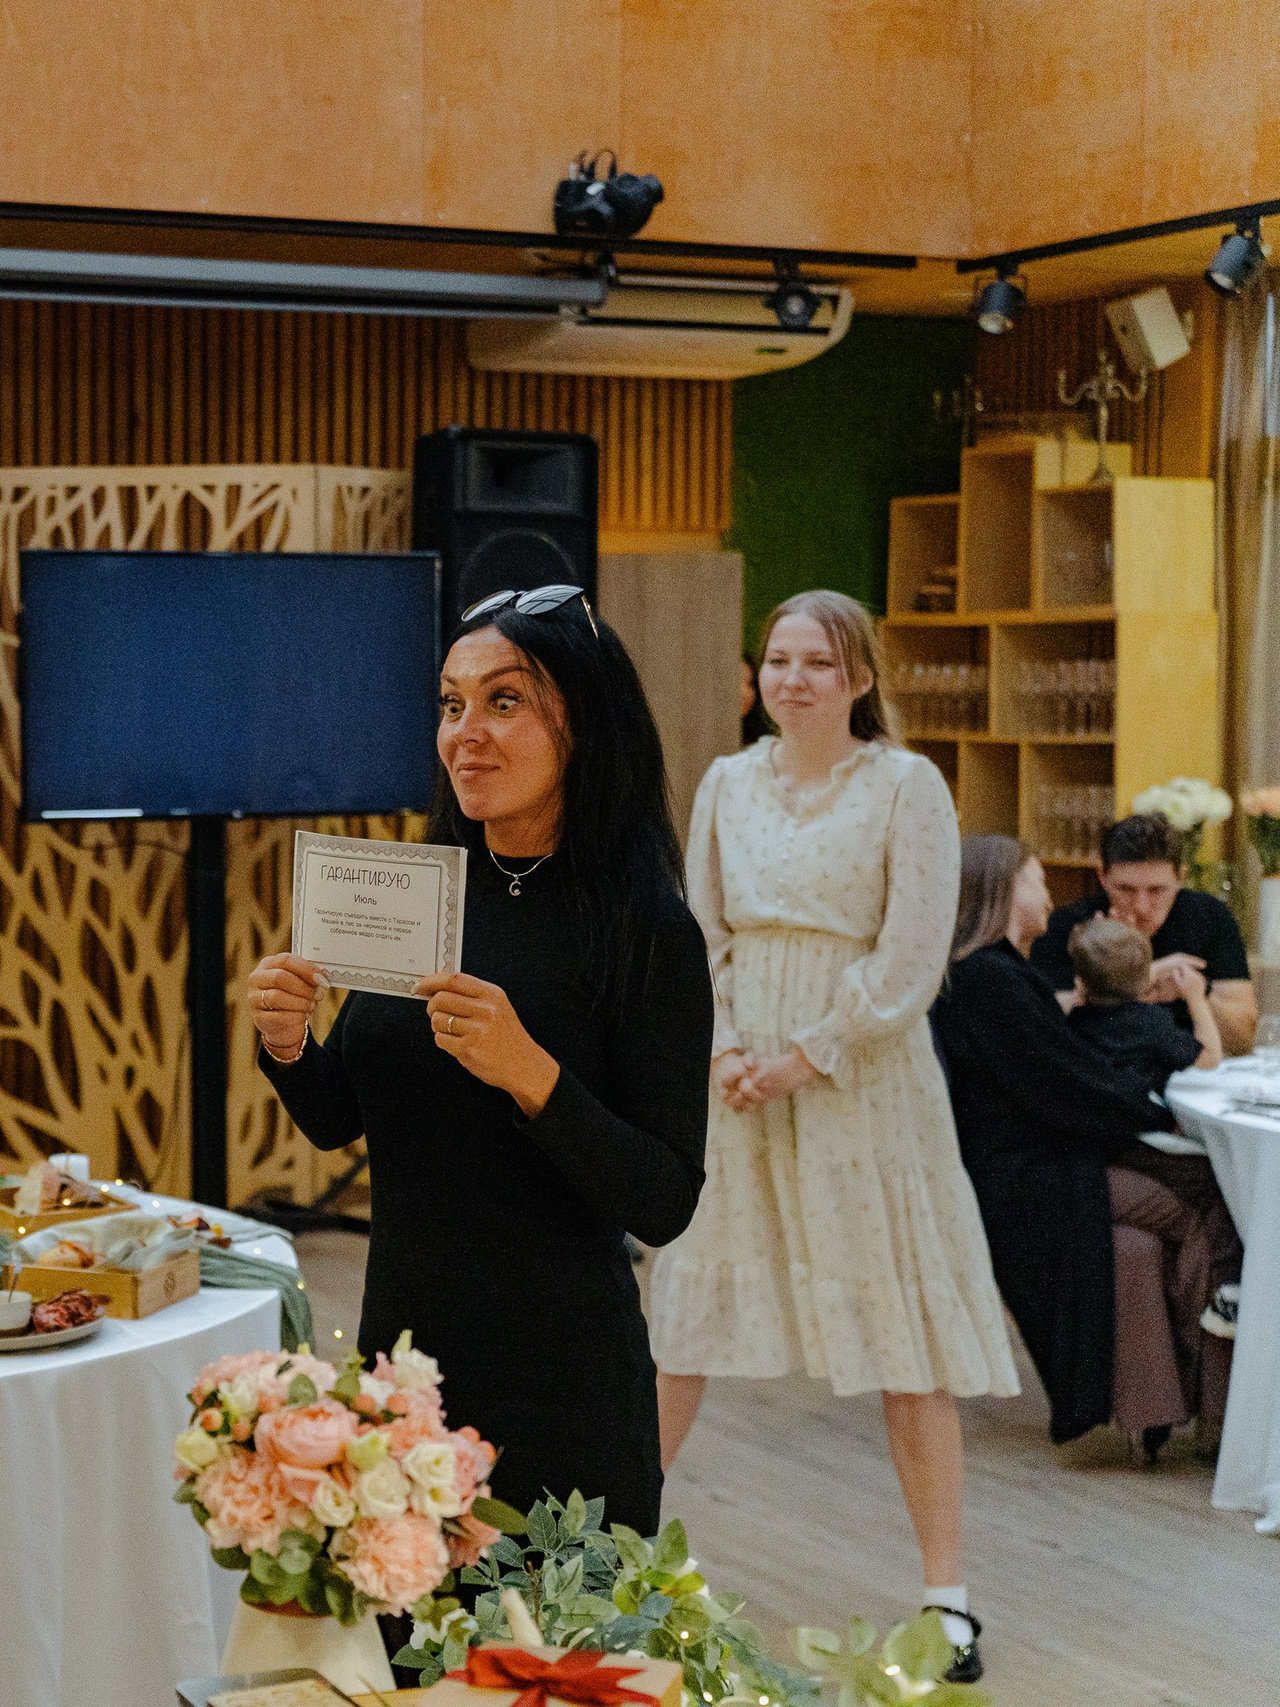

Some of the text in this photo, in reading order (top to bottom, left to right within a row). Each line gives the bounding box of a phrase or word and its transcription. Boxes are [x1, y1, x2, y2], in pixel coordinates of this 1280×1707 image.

[321, 865, 410, 889] ГАРАНТИРУЮ
[354, 893, 378, 905] Июль
[314, 907, 343, 918] Гарантирую
[344, 912, 368, 920] съездить
[369, 915, 387, 923] вместе
[392, 917, 415, 926] Тарасом
[321, 917, 339, 925] Машей
[363, 923, 387, 931] черникой
[393, 926, 412, 934] первое
[329, 927, 358, 936] собранное
[358, 930, 374, 938] ведро
